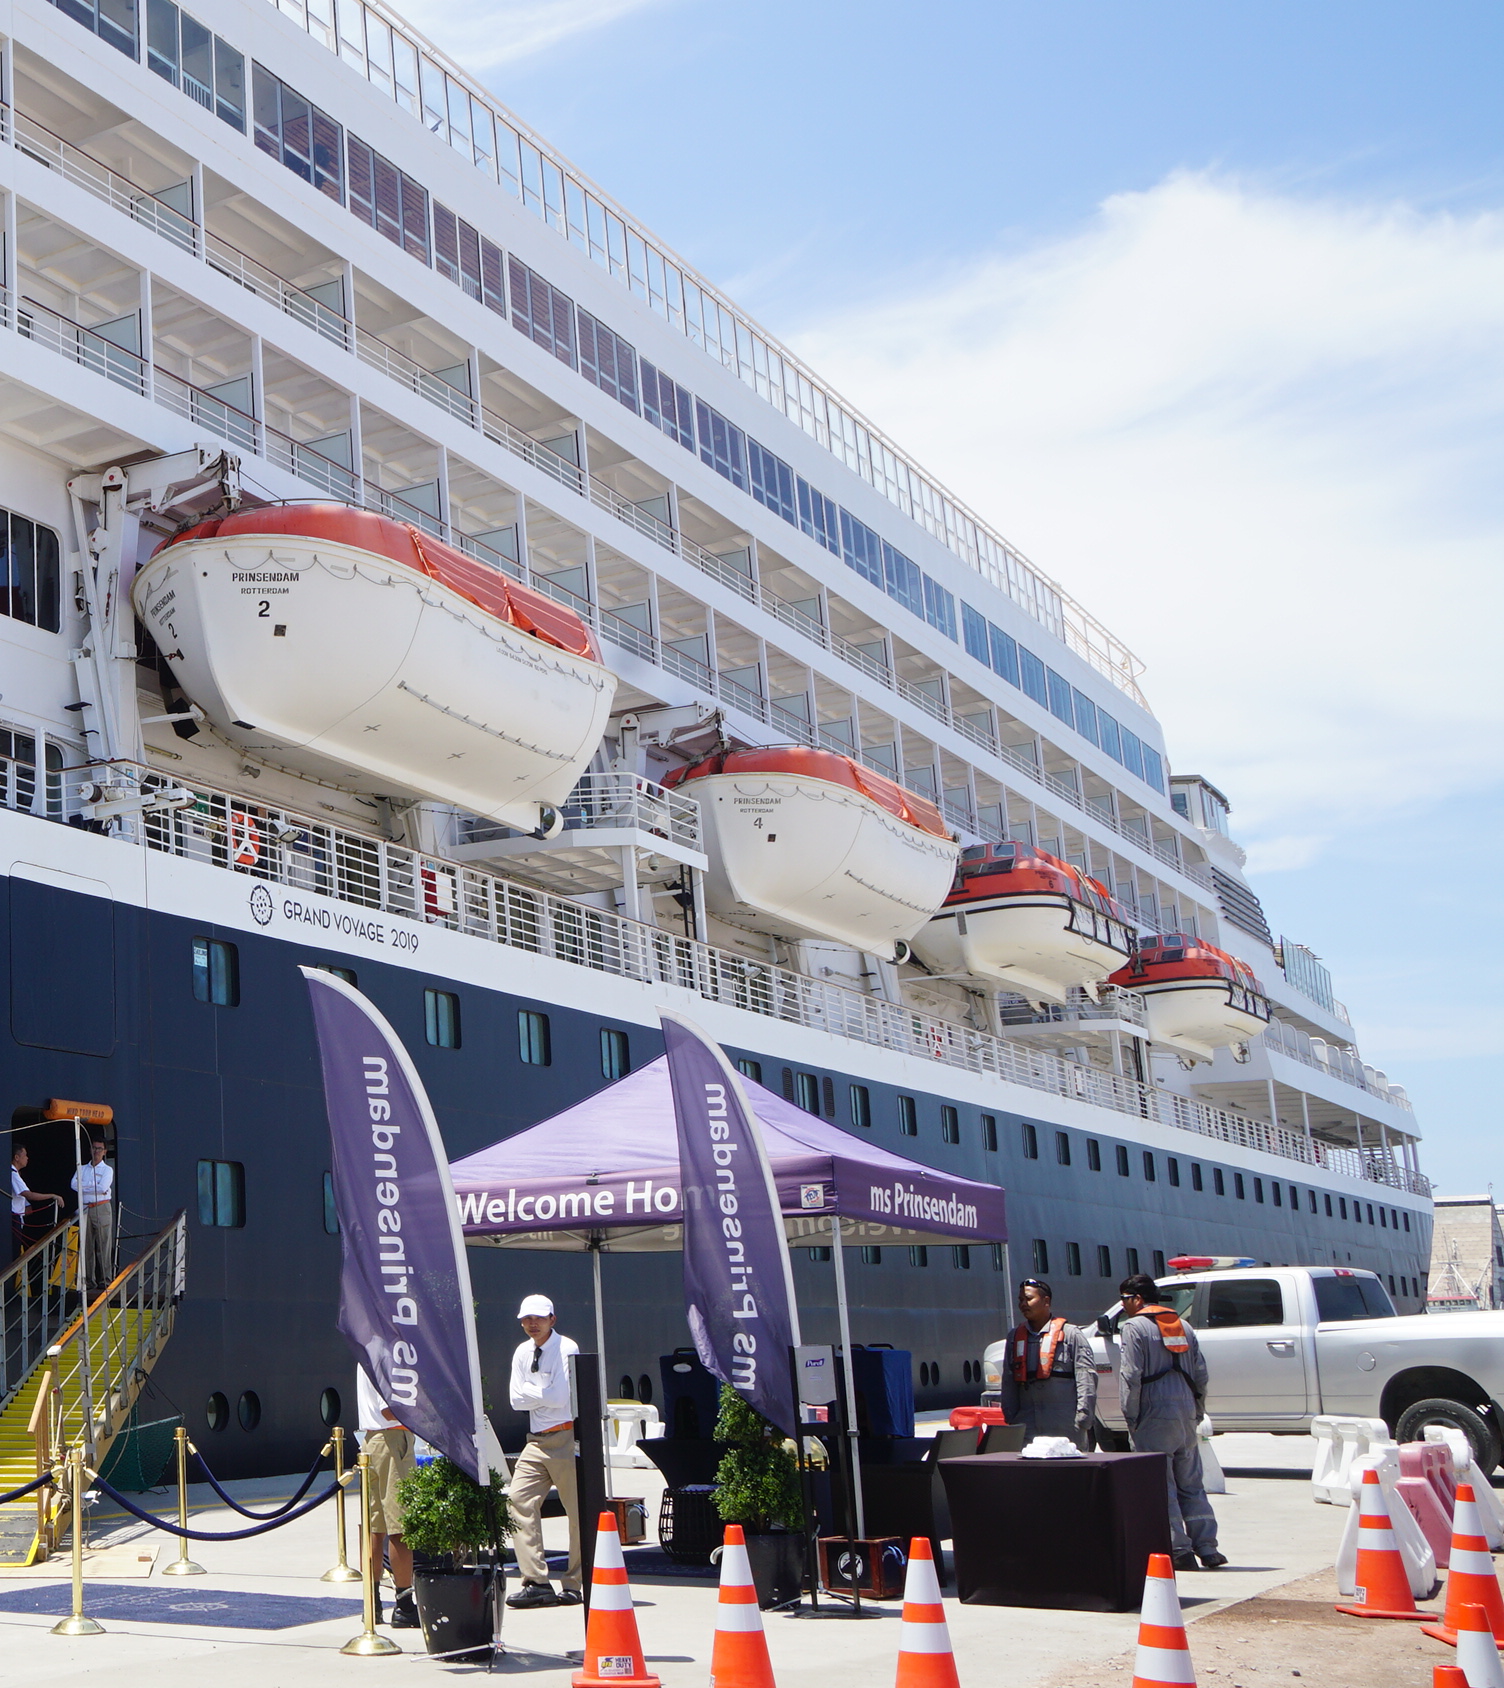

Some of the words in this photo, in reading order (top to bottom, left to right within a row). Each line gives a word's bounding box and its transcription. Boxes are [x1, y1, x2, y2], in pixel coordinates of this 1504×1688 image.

[232, 572, 300, 582] PRINSENDAM
[240, 587, 290, 595] ROTTERDAM
[258, 600, 271, 617] 2
[168, 622, 178, 639] 2
[733, 797, 782, 805] PRINSENDAM
[753, 816, 764, 830] 4
[283, 899, 331, 930] GRAND
[333, 912, 385, 944] VOYAGE
[390, 928, 420, 954] 2019
[92, 1110, 104, 1118] HEAD
[454, 1188, 615, 1226] Welcome
[870, 1185, 891, 1214] ms
[894, 1182, 978, 1229] Prinsendam
